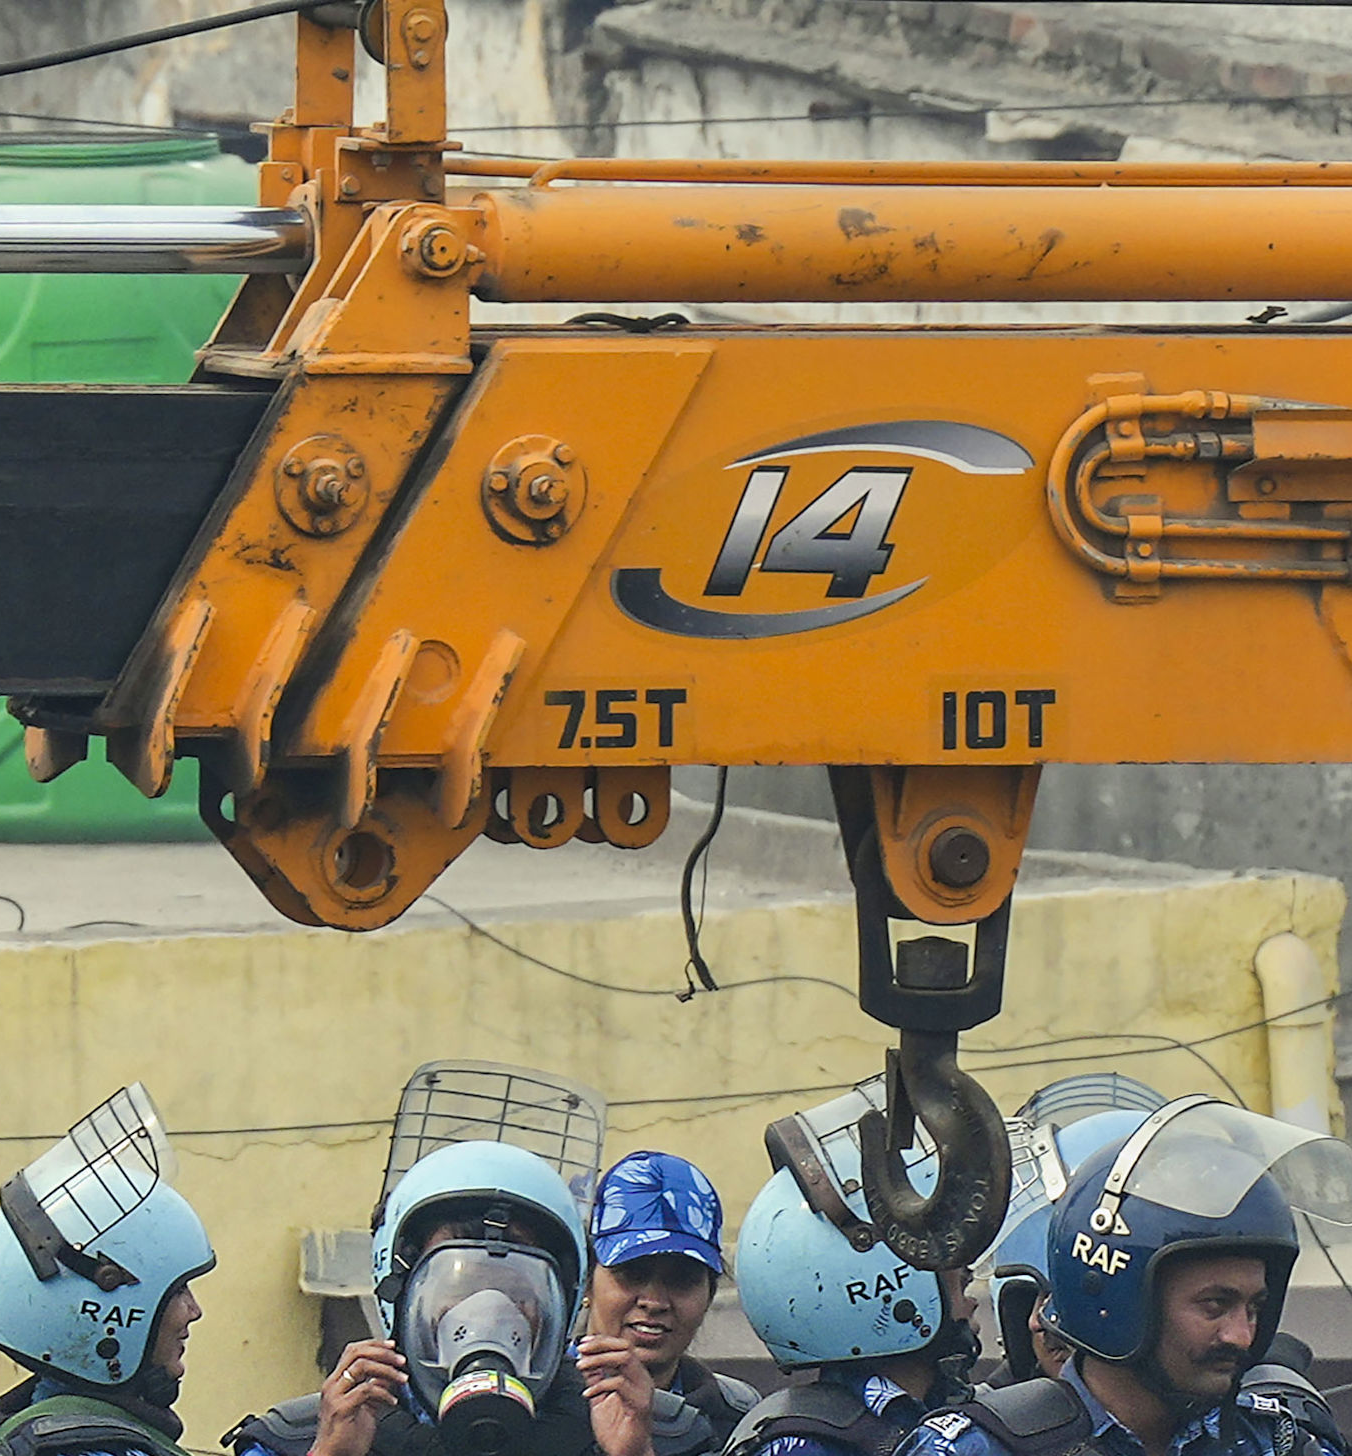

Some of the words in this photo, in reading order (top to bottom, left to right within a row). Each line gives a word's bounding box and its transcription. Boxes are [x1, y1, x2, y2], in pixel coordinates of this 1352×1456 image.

[703, 465, 915, 598] 14
[544, 688, 687, 750] 7.5T
[942, 689, 1057, 750] 10T
[1072, 1232, 1131, 1275] RAF
[846, 1264, 911, 1305] RAF
[81, 1300, 145, 1328] RAF
